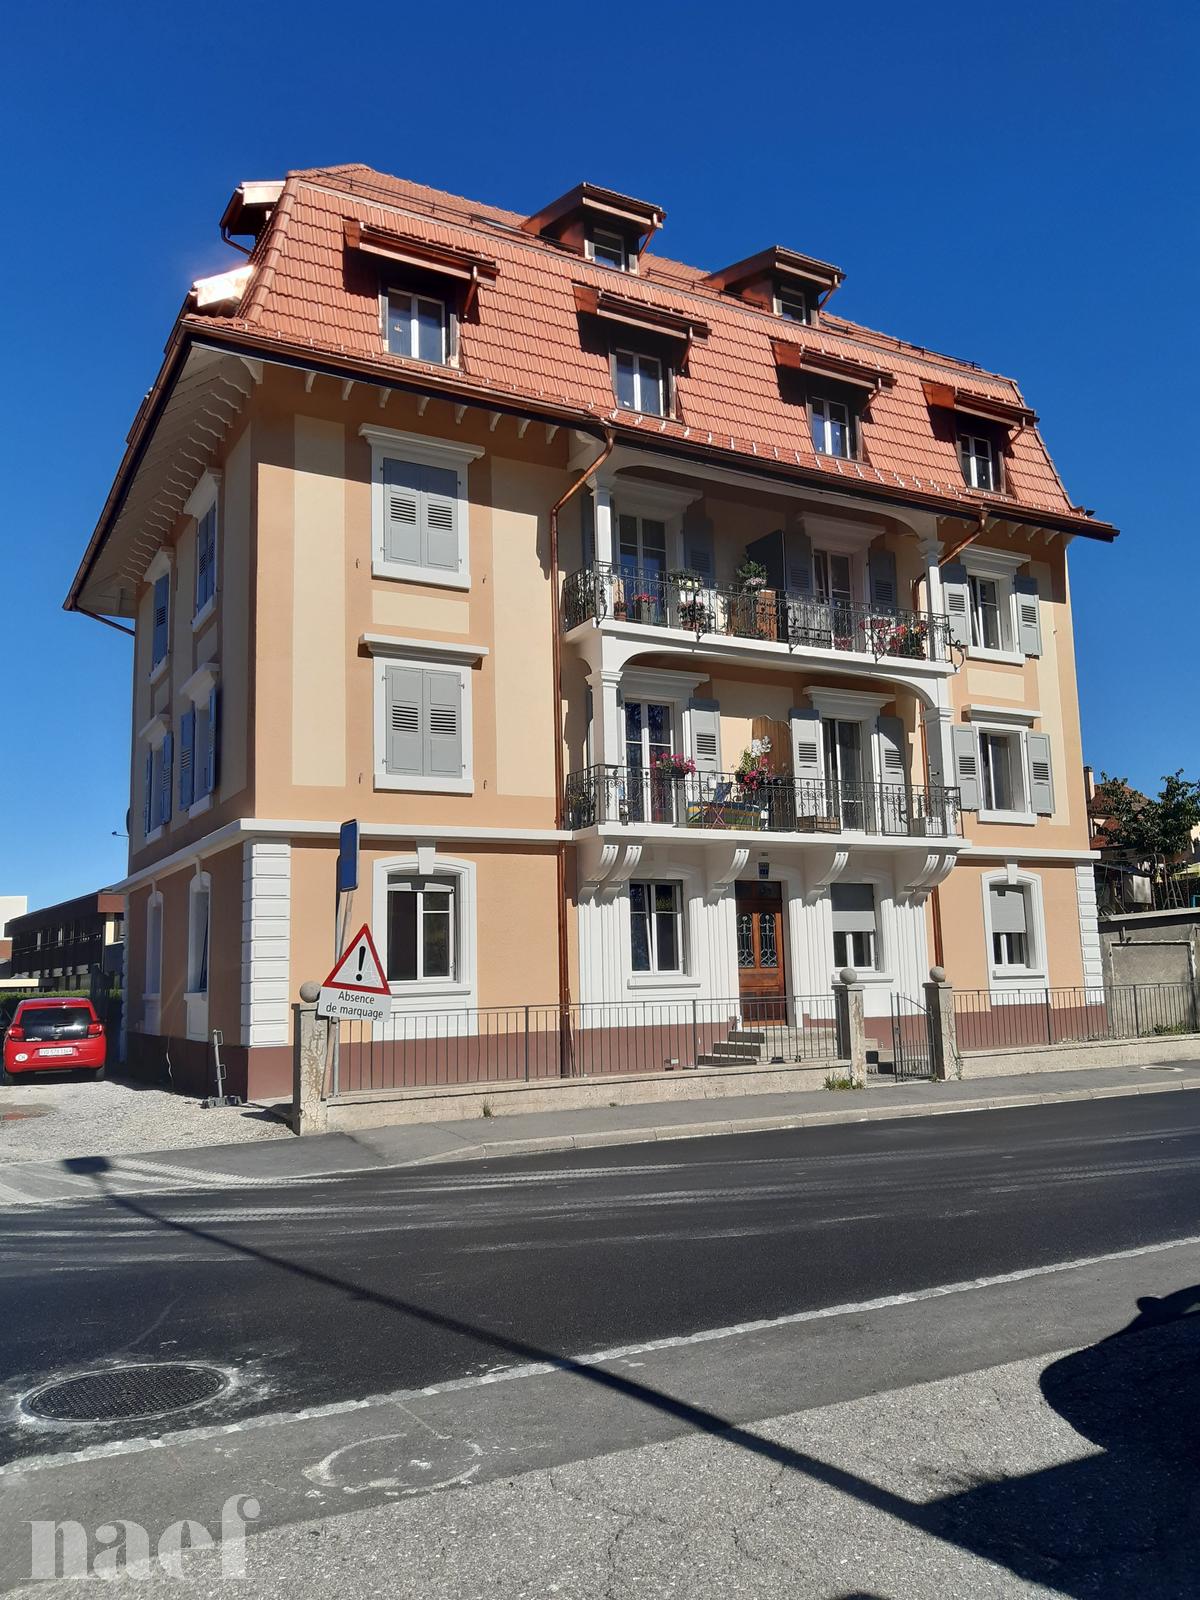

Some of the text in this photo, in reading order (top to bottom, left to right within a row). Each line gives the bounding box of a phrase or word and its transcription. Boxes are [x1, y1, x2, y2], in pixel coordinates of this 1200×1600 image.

[338, 991, 375, 1004] Absence
[326, 1002, 384, 1020] de marquage
